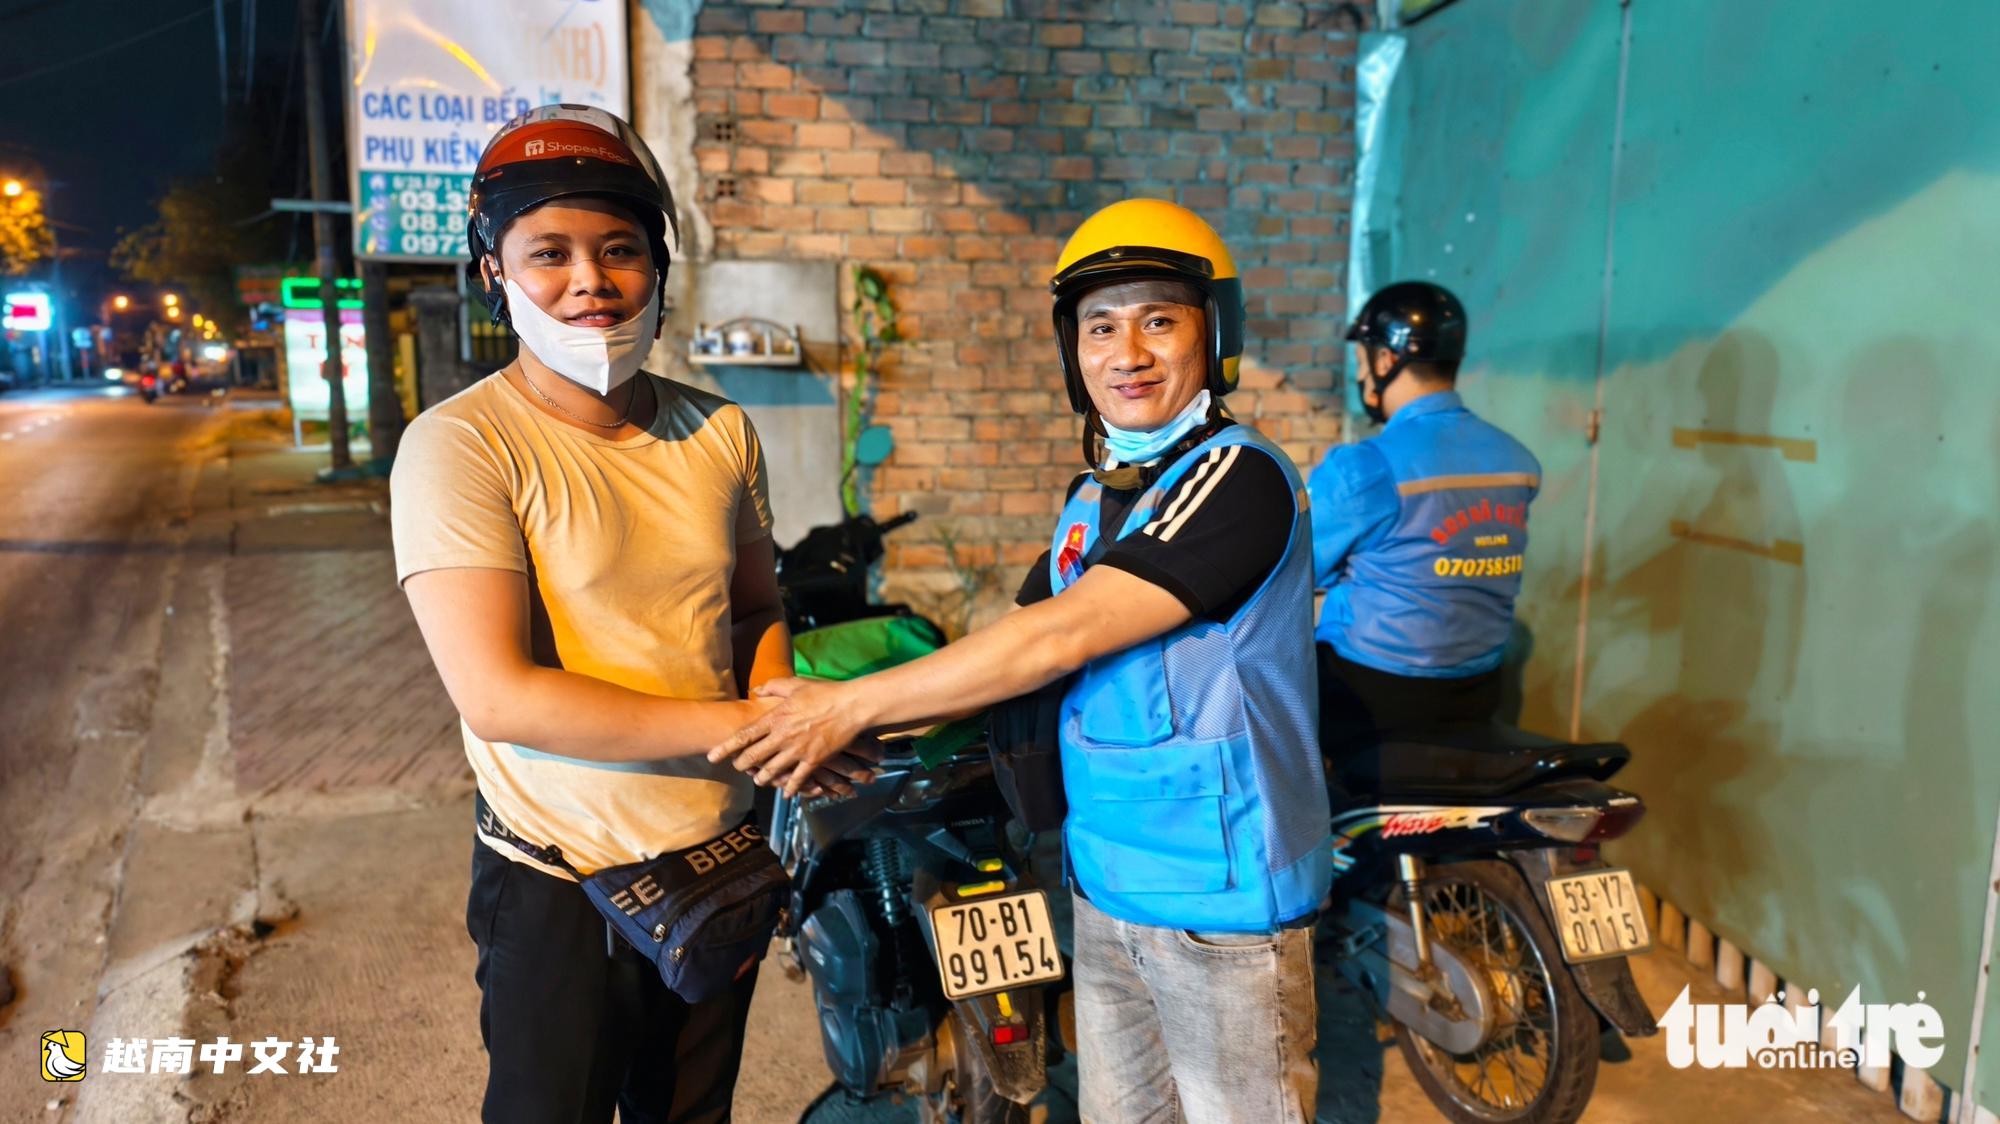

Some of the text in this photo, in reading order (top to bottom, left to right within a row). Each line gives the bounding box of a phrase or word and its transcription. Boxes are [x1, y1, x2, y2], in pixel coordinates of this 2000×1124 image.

[363, 86, 412, 121] CÁC
[419, 94, 475, 128] LOẠI
[365, 135, 414, 168] PHỤ
[400, 190, 469, 213] 03.3
[1561, 875, 1623, 914] 53-Y7
[952, 899, 1033, 946] 70-B1
[1572, 913, 1639, 953] 0115
[949, 937, 1055, 990] 991.54
